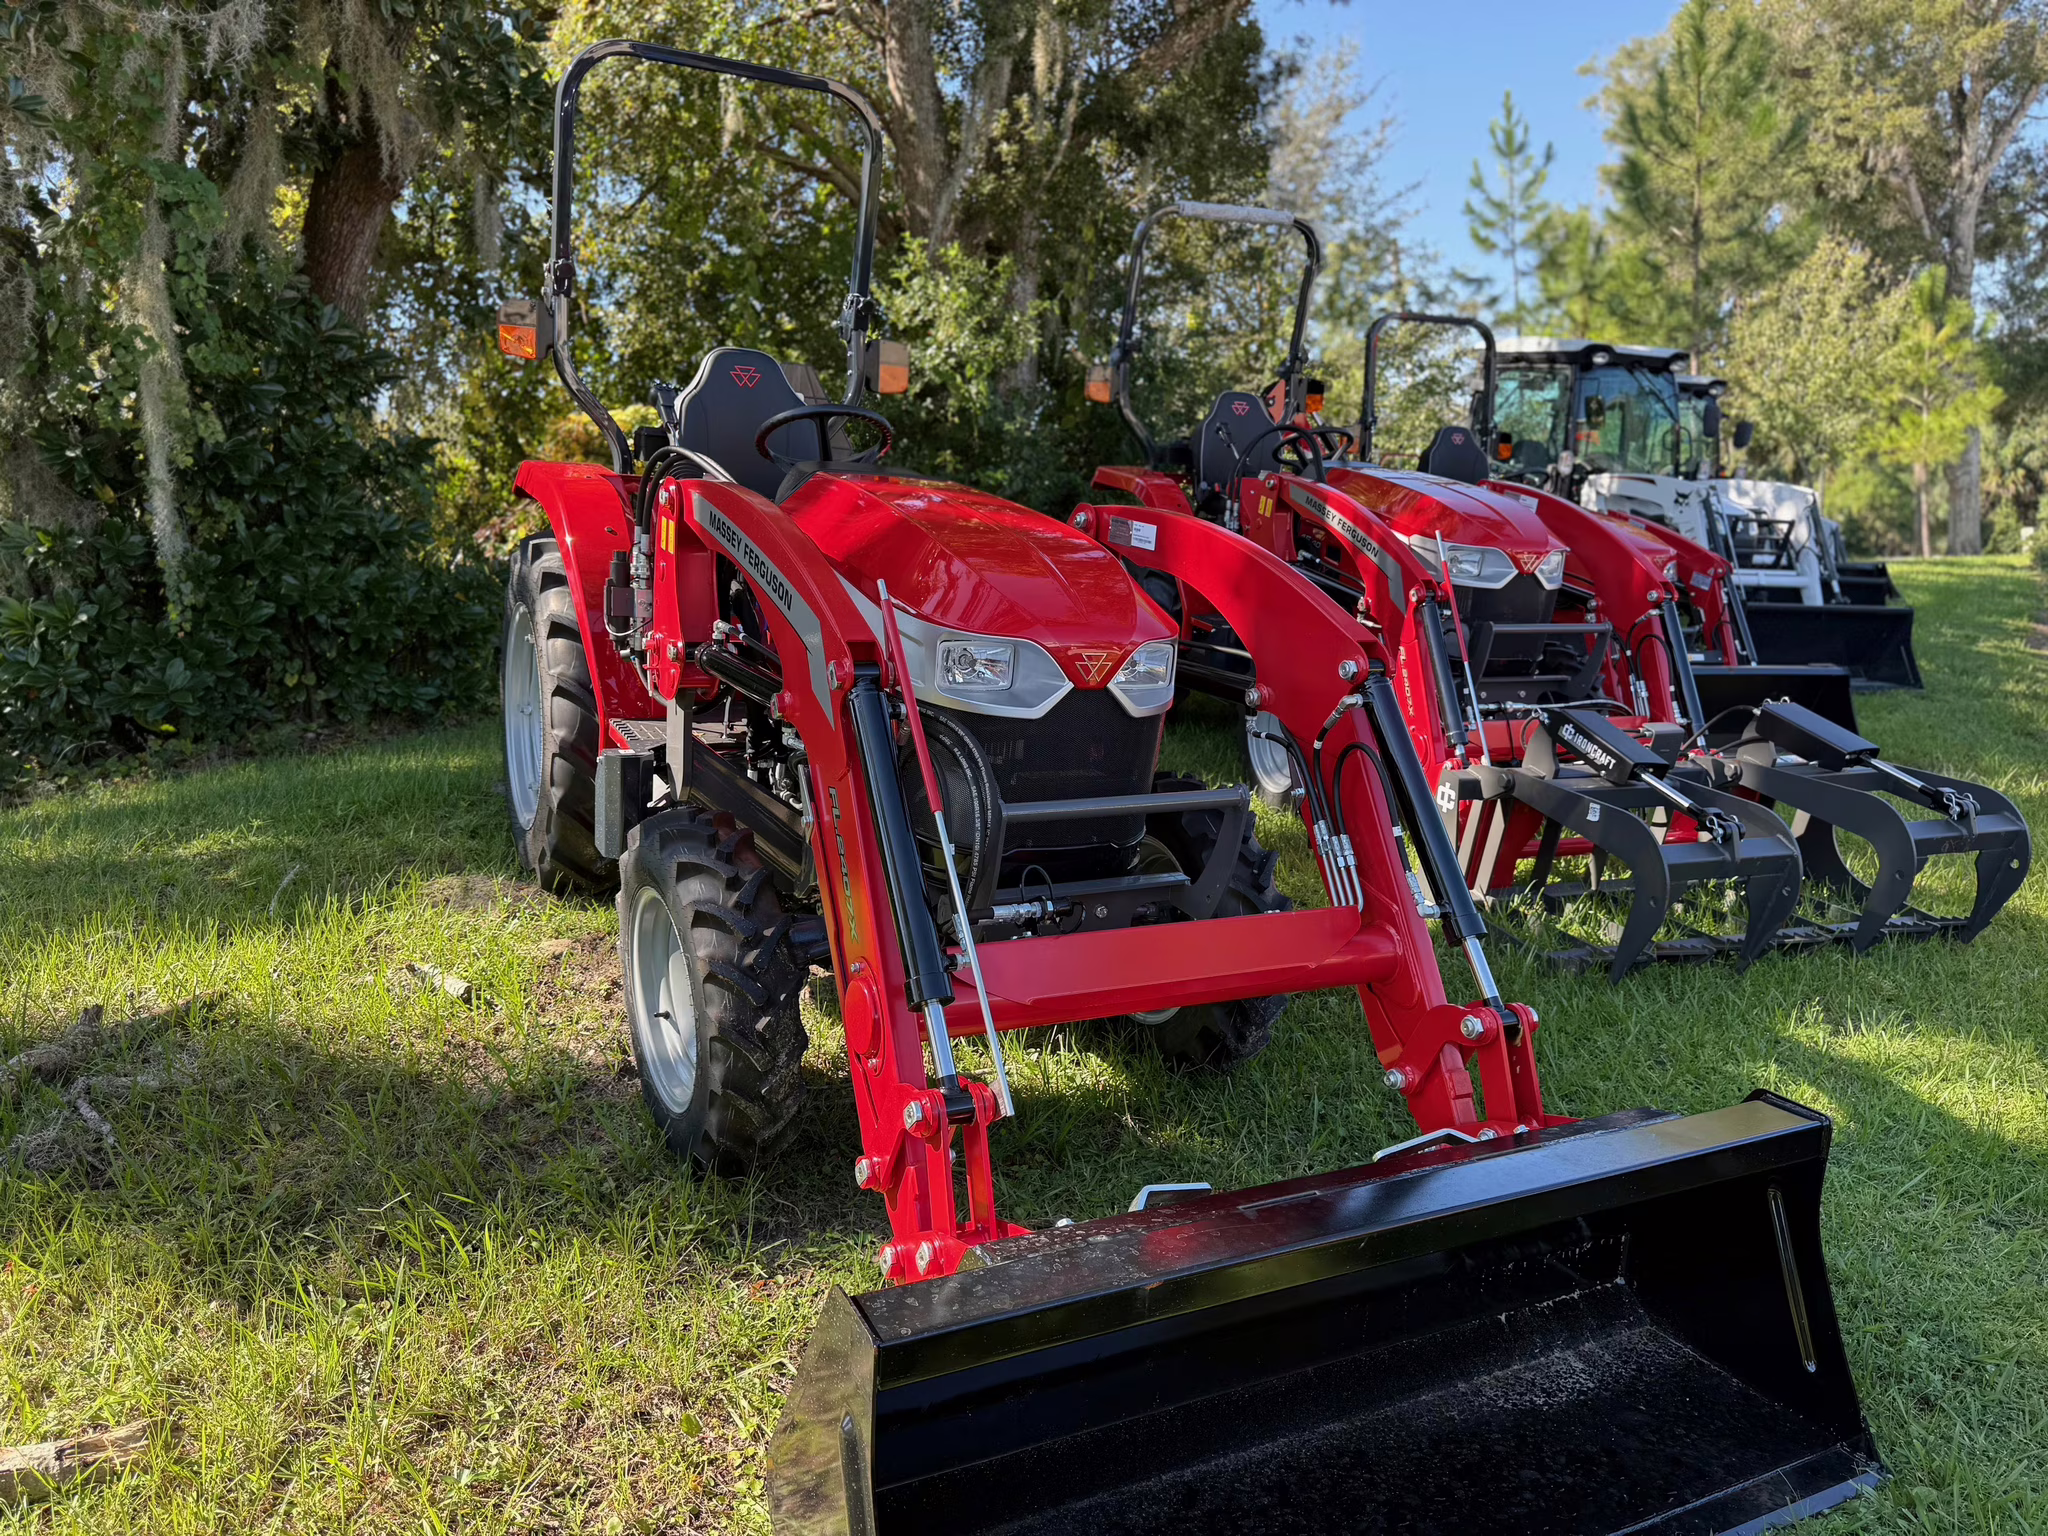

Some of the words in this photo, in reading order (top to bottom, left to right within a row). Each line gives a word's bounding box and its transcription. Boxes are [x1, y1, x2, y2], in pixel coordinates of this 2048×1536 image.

[709, 510, 742, 552] MASSEY
[743, 542, 793, 612] FERGUSON
[1305, 496, 1337, 522] MASSEY
[1337, 518, 1379, 558] FERGUSON
[1398, 645, 1416, 718] FL.2407X
[1573, 732, 1616, 770] IRONCRAFT
[828, 785, 858, 944] FL.2407X
